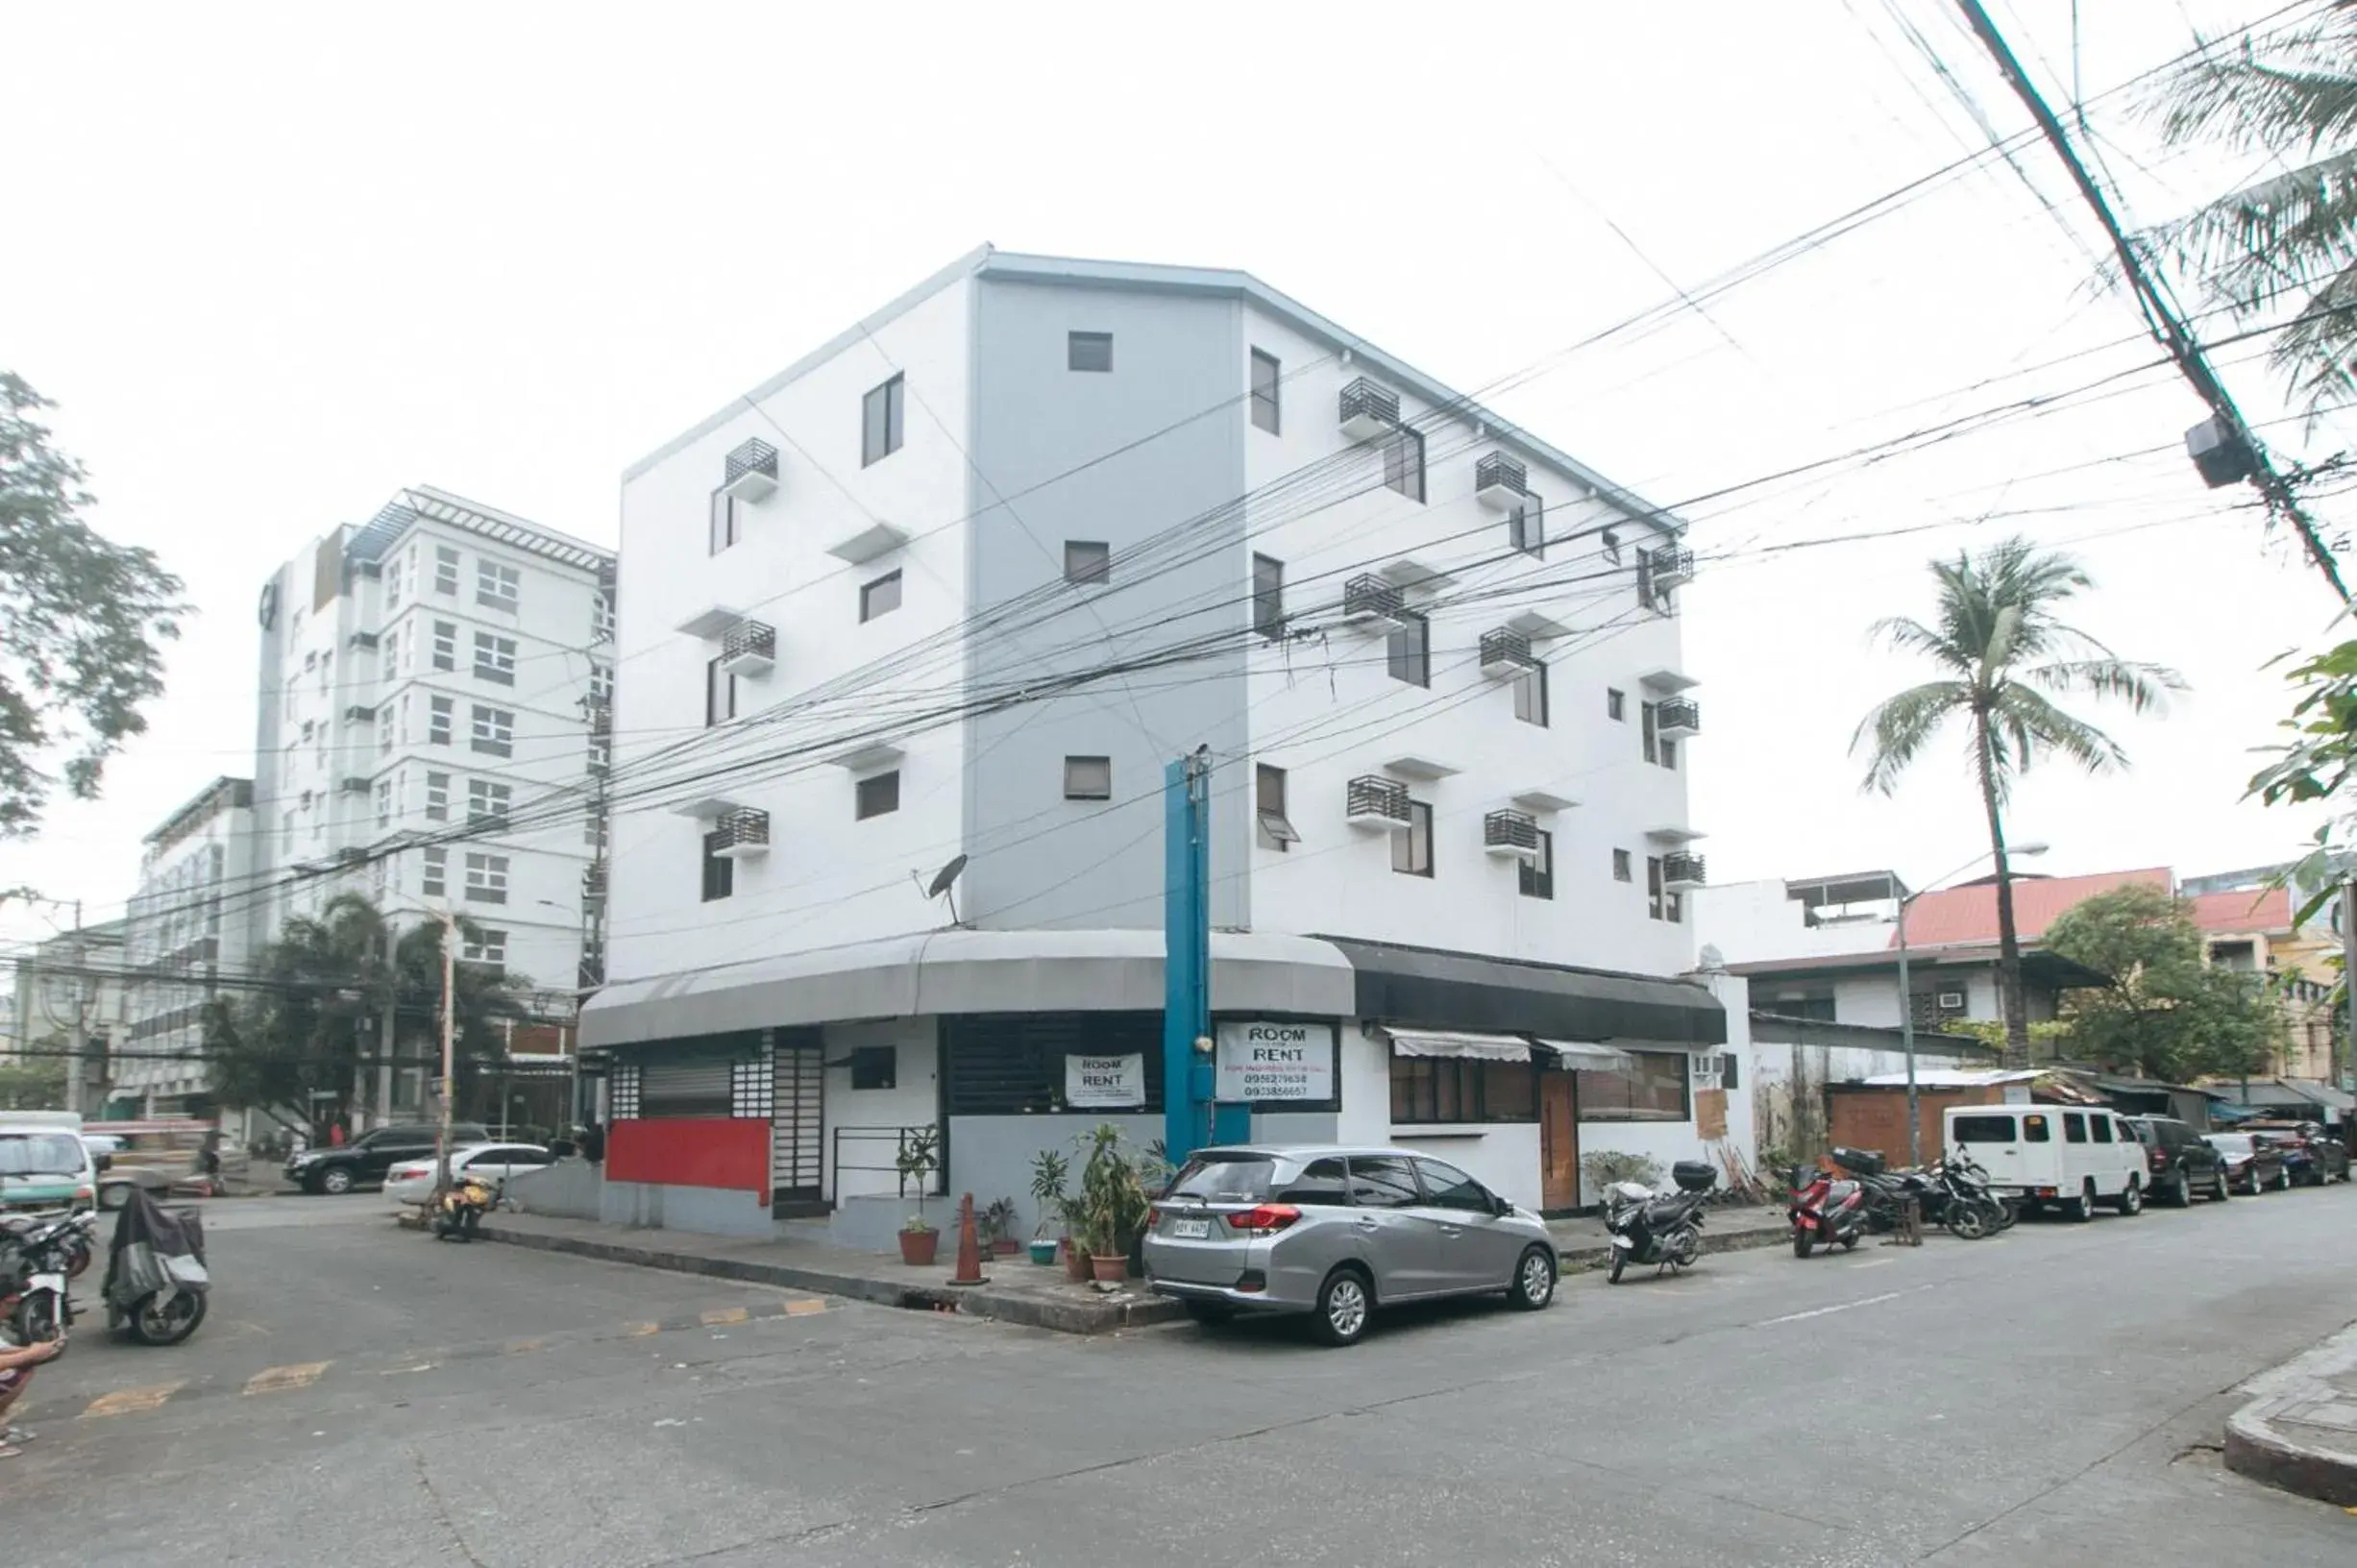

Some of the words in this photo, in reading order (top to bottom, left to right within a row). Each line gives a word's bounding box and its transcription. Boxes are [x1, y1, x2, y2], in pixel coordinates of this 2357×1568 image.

[1249, 1027, 1306, 1041] ROOM
[1253, 1048, 1304, 1062] RENT
[1082, 1059, 1122, 1069] ROOM
[1082, 1074, 1122, 1087] RENT
